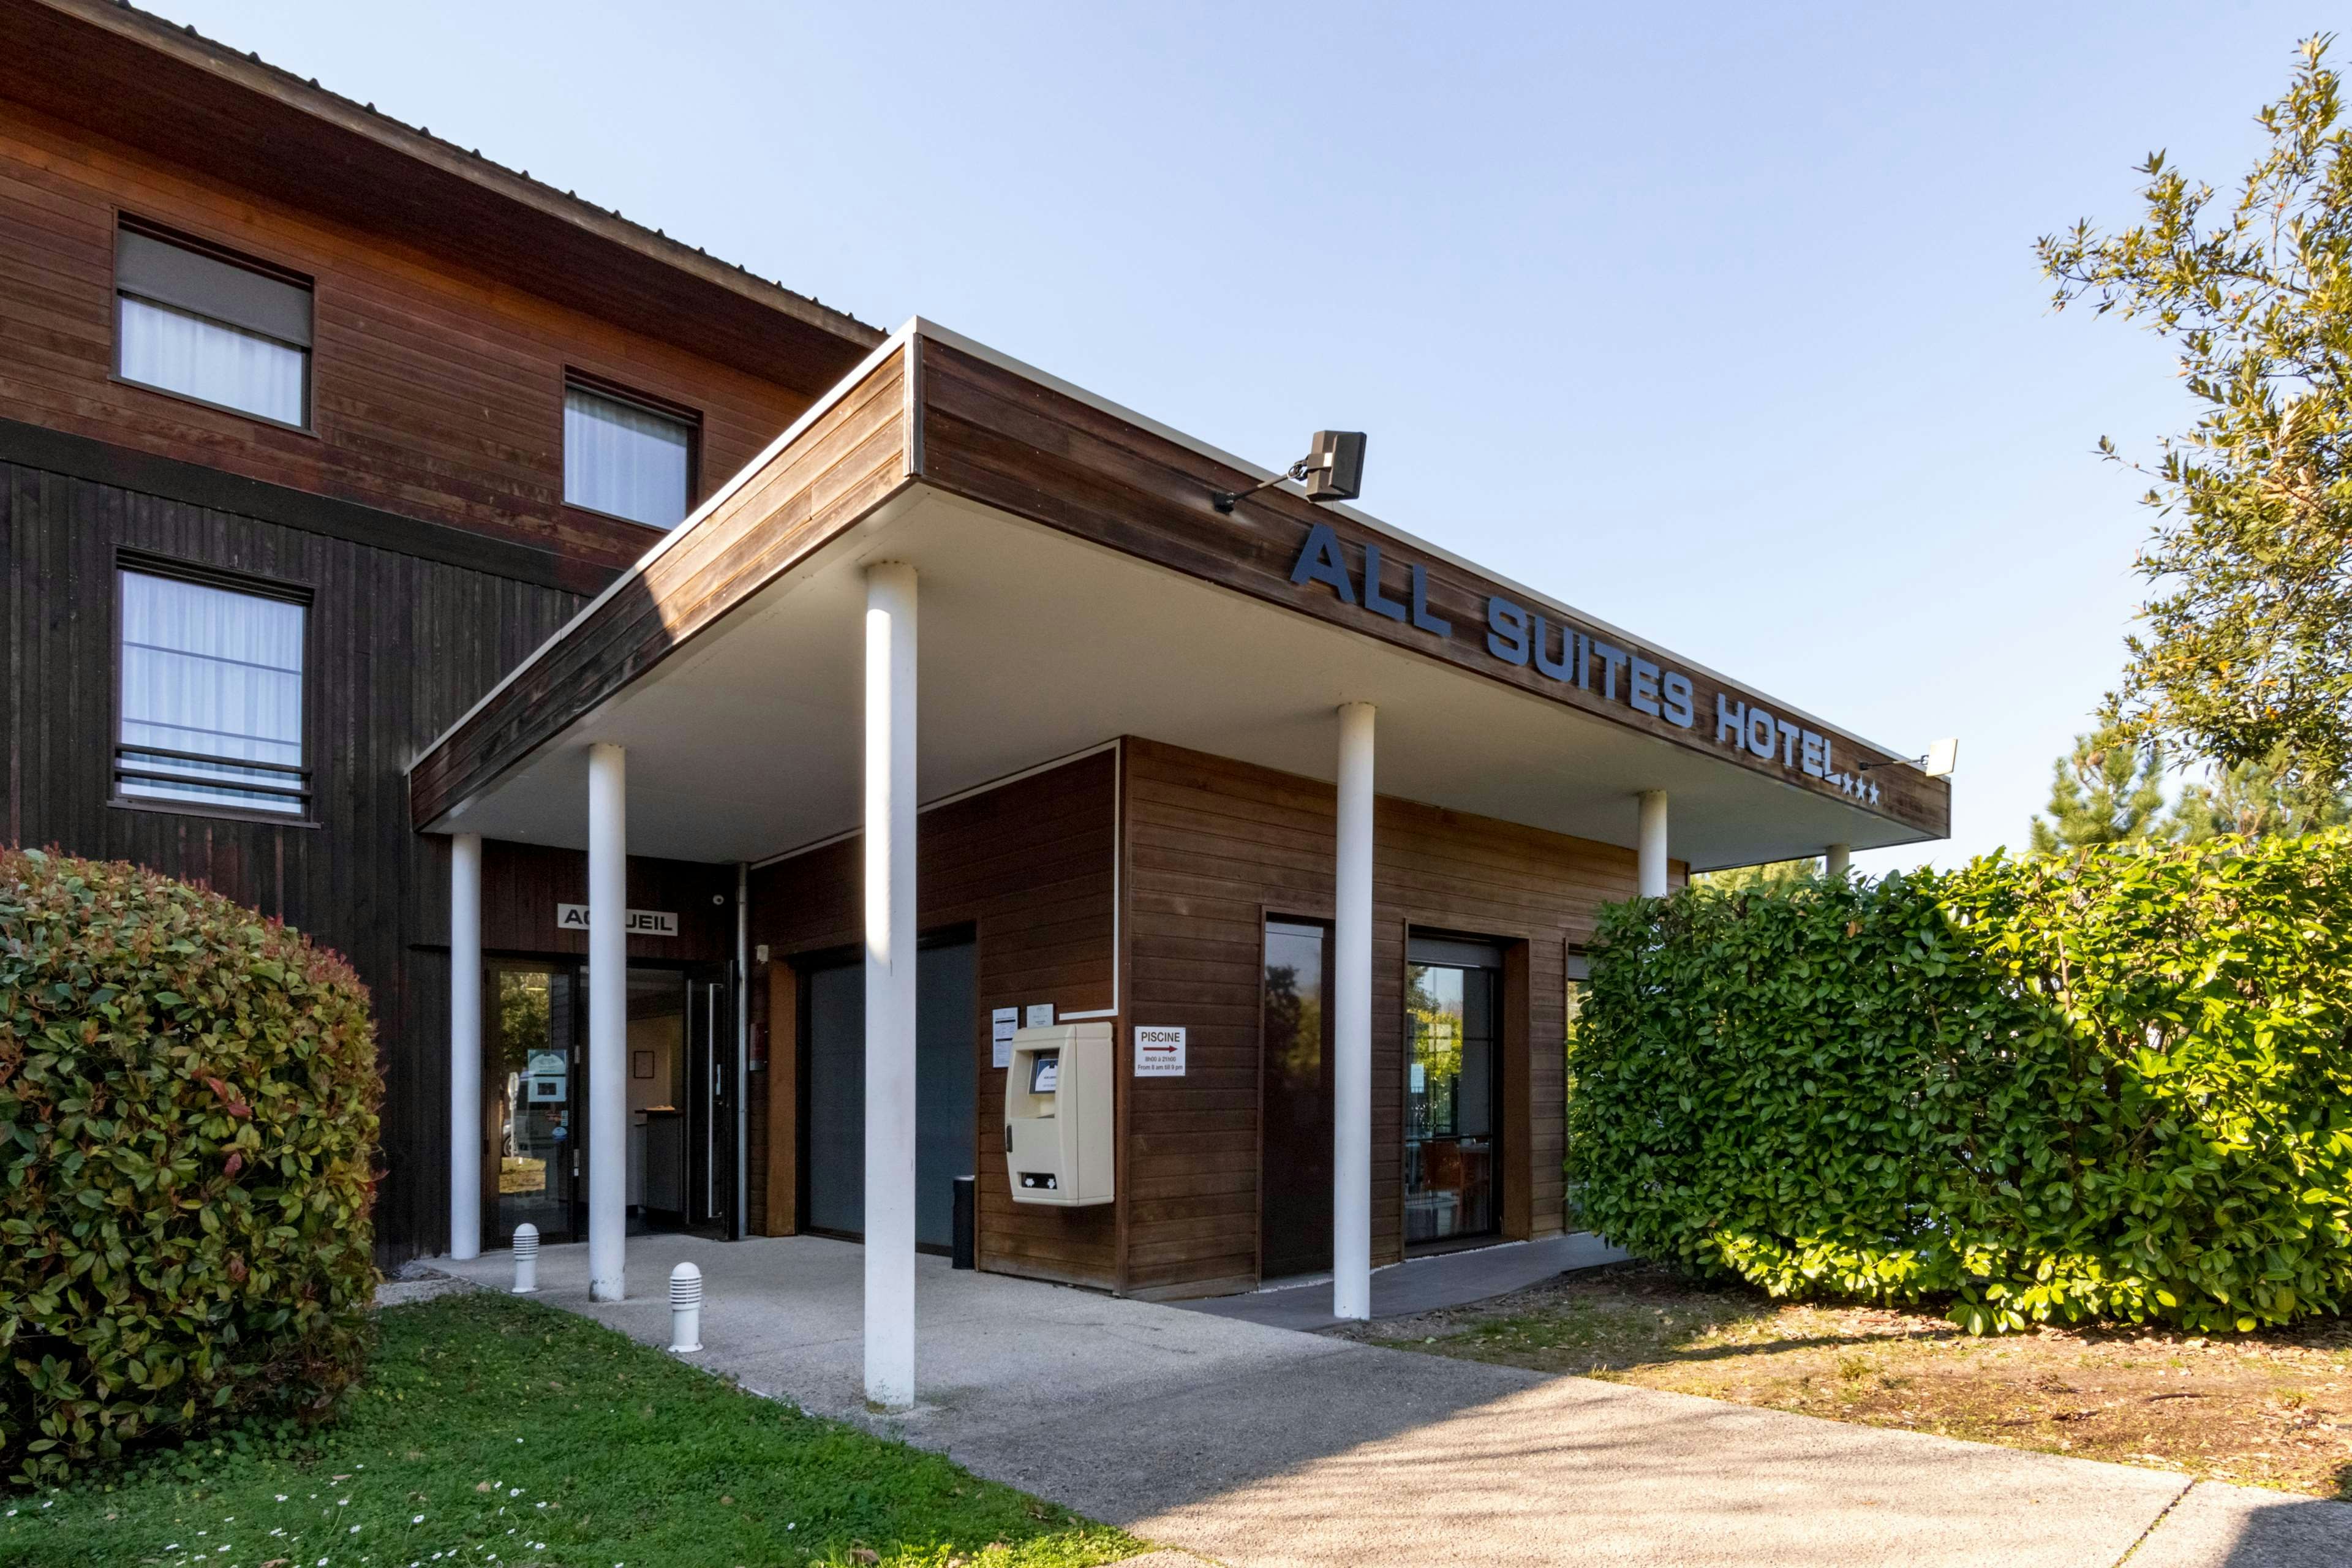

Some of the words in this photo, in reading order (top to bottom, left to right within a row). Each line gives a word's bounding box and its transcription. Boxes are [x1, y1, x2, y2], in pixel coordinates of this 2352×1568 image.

[1291, 523, 1451, 638] ALL
[1487, 597, 1694, 729] SUITES
[1717, 693, 1841, 785] HOTEL
[1141, 1031, 1180, 1042] PISCINE
